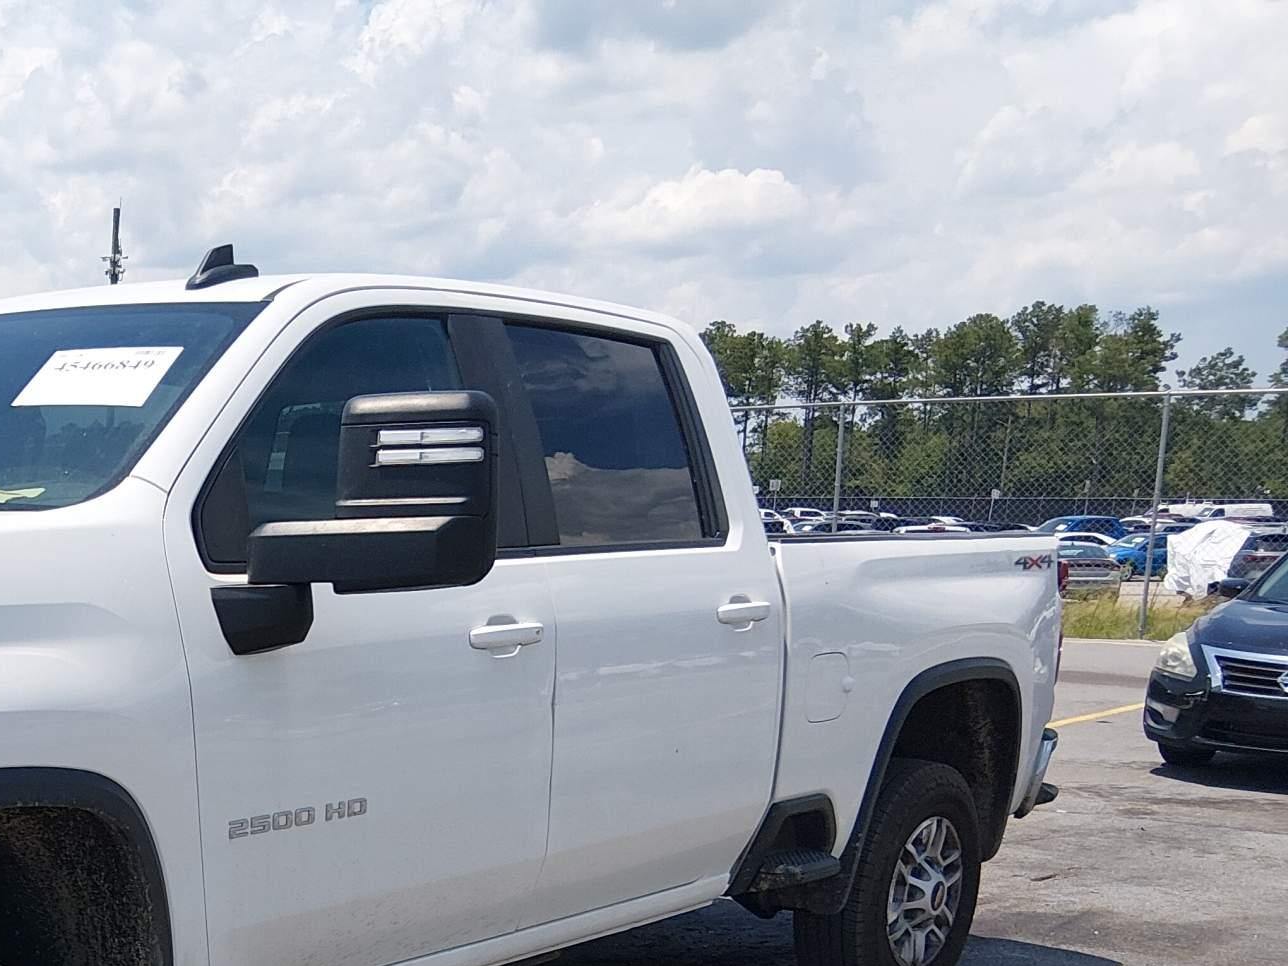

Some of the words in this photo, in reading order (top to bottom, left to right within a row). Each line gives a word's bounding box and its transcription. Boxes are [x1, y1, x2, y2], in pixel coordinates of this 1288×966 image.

[53, 358, 157, 372] 45466849
[228, 806, 316, 840] 2500
[325, 797, 368, 822] HD
